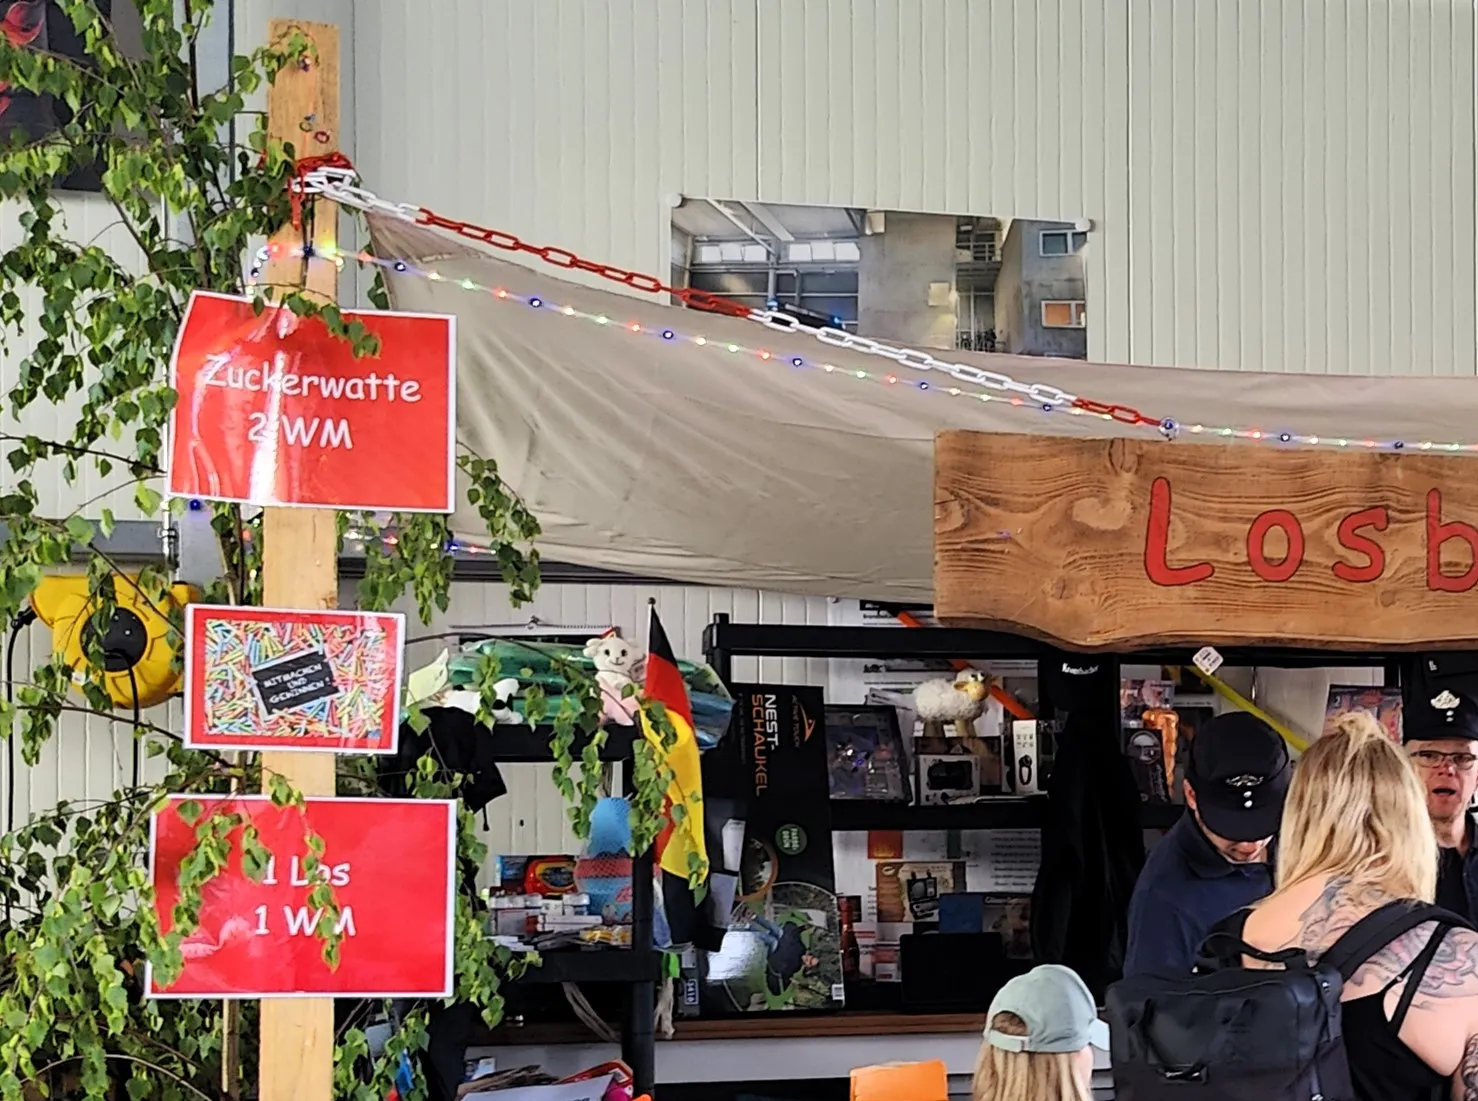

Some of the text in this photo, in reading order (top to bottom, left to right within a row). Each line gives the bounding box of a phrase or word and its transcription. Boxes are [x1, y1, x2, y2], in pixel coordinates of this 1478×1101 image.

[204, 352, 422, 403] Zuckerwatte
[247, 411, 353, 449] 2 WM
[263, 663, 323, 689] MITMACHEN
[287, 677, 308, 690] UND
[764, 693, 779, 751] NEST-
[751, 693, 769, 797] SCHAUKEL
[261, 855, 278, 885] 1
[254, 904, 271, 936] 1
